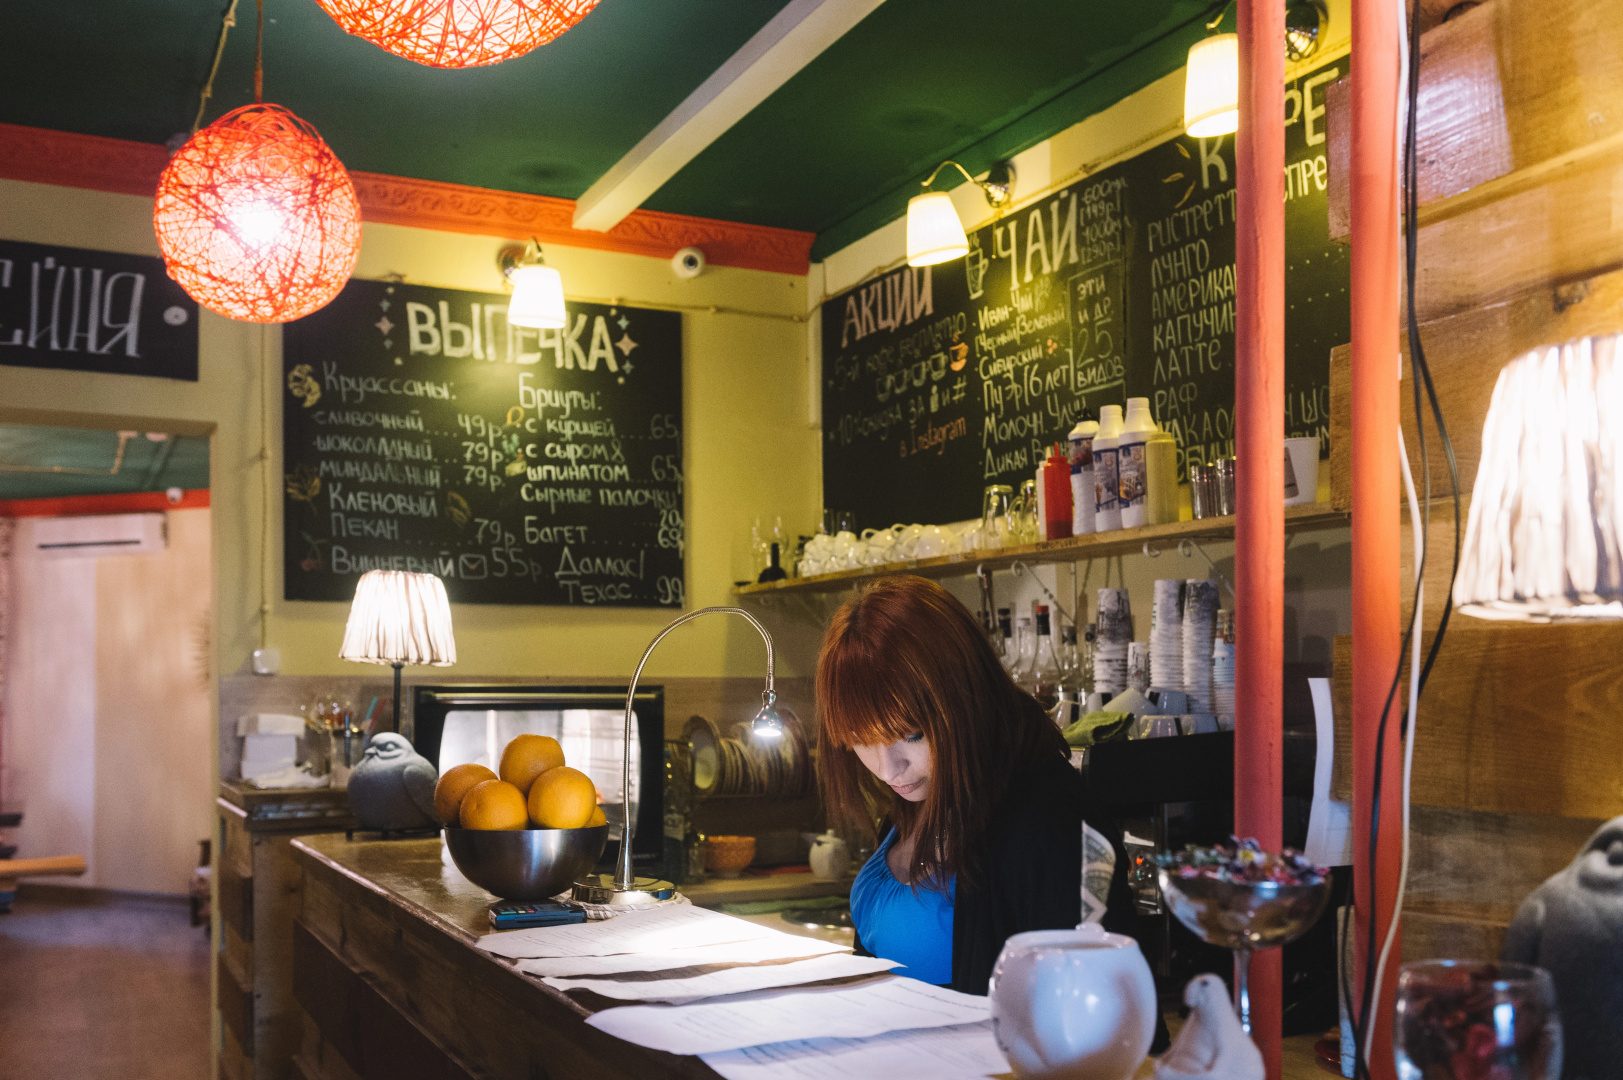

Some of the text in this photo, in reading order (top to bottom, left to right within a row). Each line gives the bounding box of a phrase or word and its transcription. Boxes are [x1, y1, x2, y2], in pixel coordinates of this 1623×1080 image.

[995, 189, 1080, 291] ЧАЙ
[1151, 238, 1210, 290] ЛУНГО
[406, 301, 619, 373] ВЫПЕЧКА
[1077, 319, 1113, 368] 25
[323, 361, 456, 403] Круассаны:
[1155, 382, 1198, 423] РАФ
[909, 417, 967, 456] Instagram
